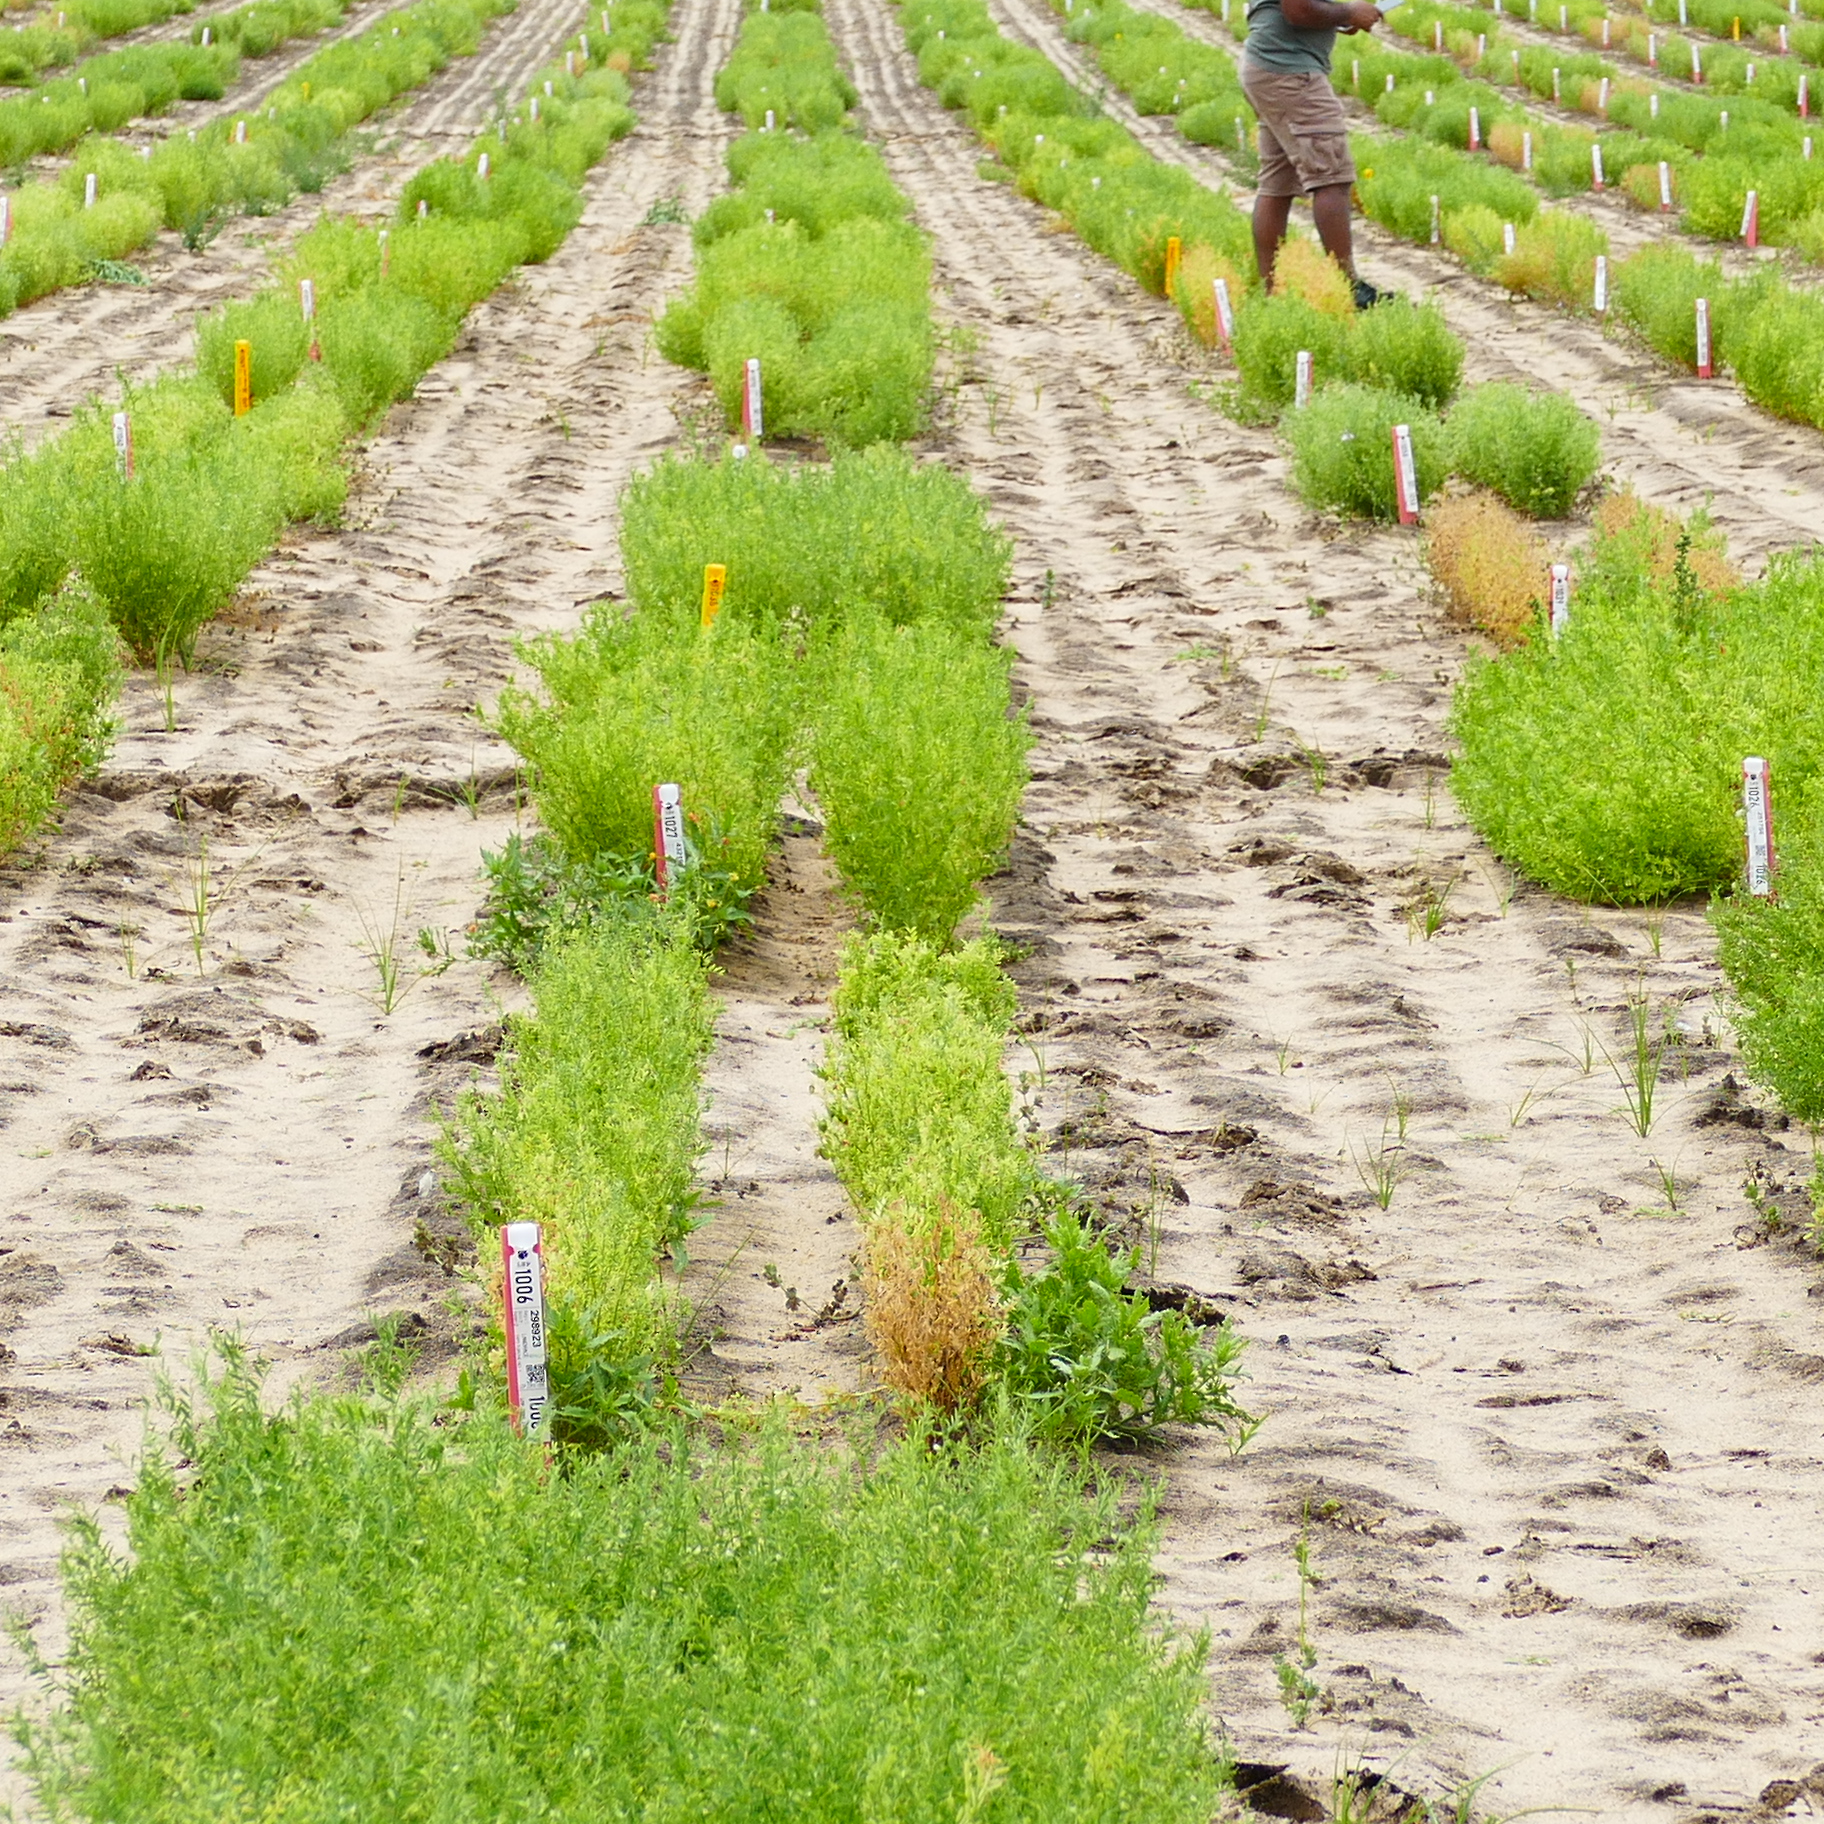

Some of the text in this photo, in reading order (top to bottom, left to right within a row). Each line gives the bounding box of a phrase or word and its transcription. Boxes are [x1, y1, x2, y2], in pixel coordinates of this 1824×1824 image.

[1748, 786, 1760, 806] 1026
[665, 816, 678, 838] 1027
[514, 1269, 533, 1304] 1006
[530, 1309, 541, 1348] 298923
